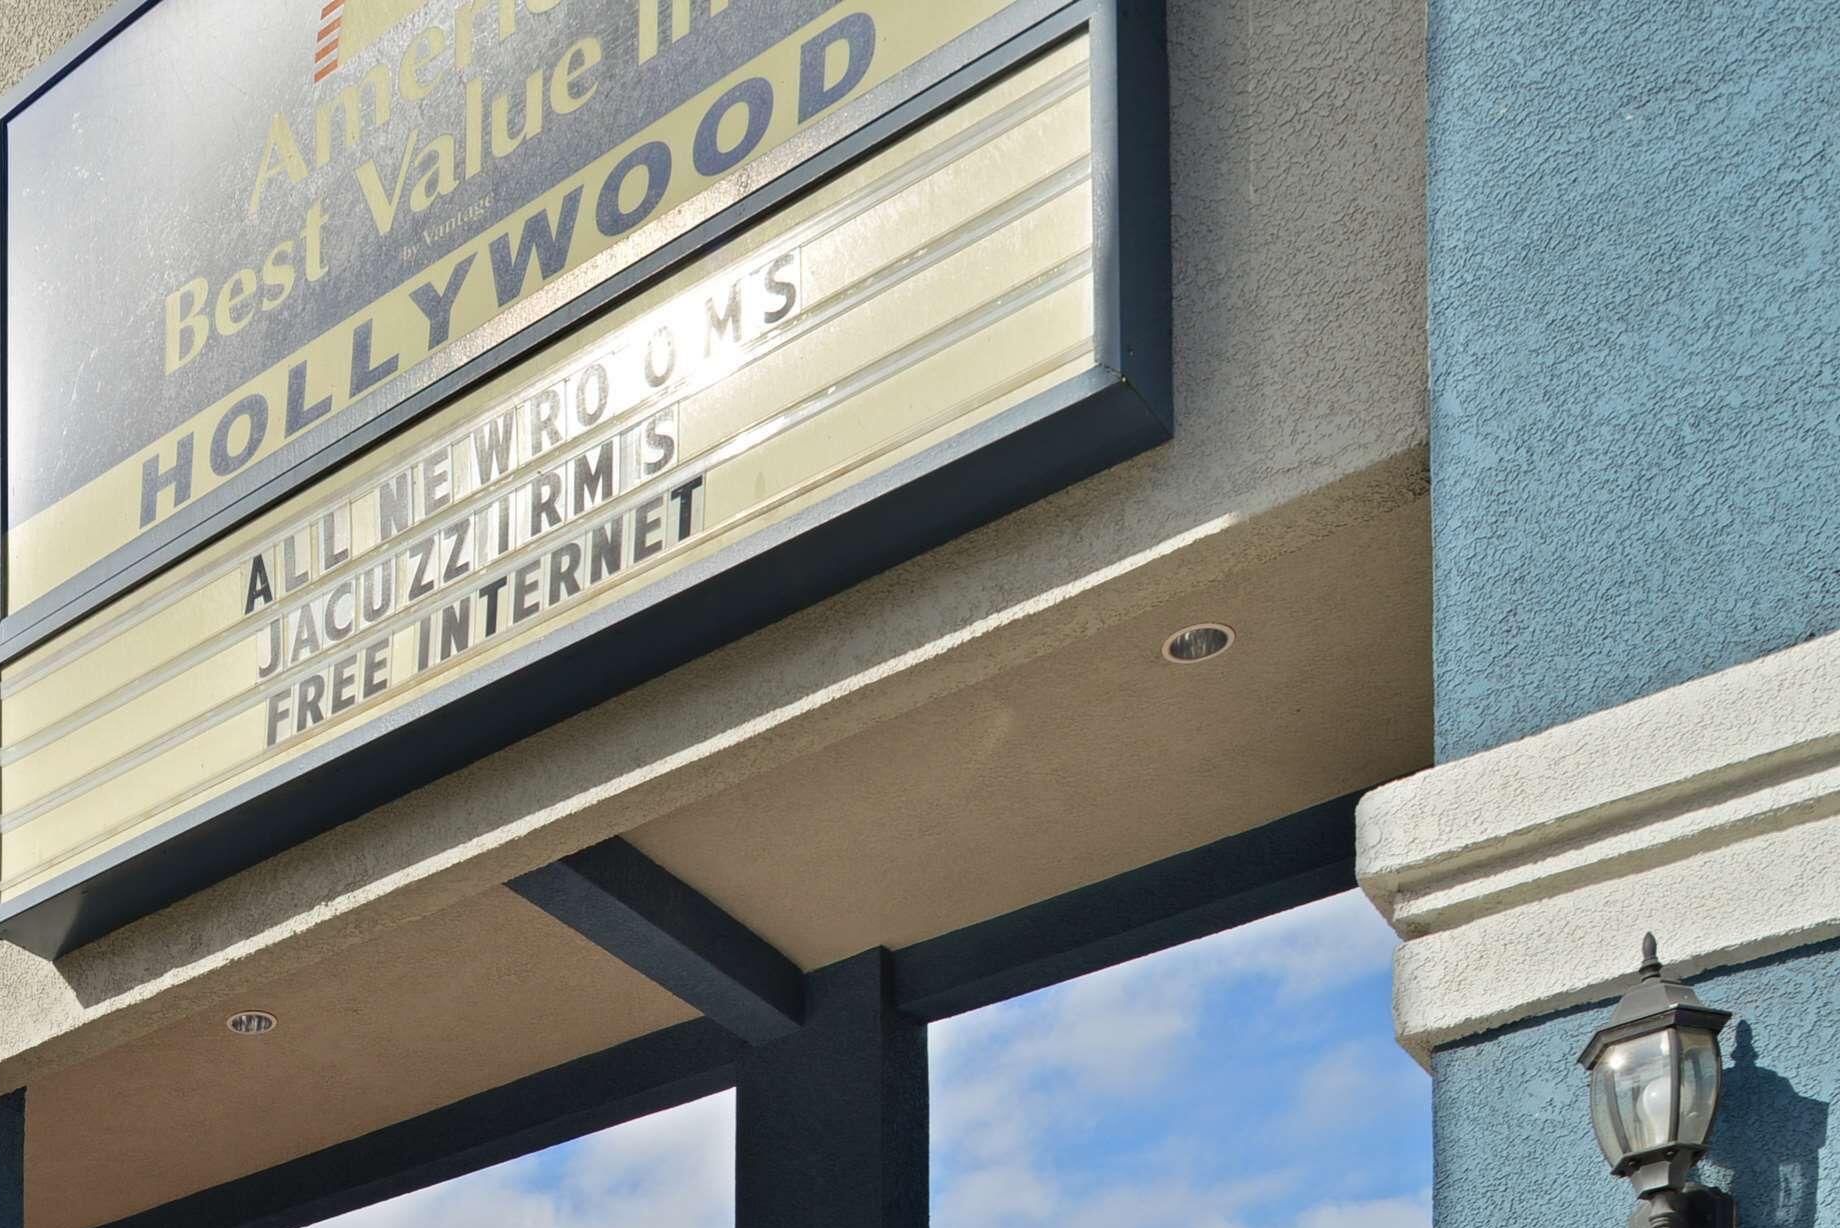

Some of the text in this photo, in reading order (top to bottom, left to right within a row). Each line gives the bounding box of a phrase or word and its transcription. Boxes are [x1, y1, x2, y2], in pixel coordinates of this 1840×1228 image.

[164, 37, 602, 376] Best Value
[248, 0, 562, 224] Ameri
[423, 191, 494, 247] Vantage
[139, 12, 877, 529] HOLLYWOOD
[244, 511, 351, 615] ALL
[266, 476, 704, 747] FREE INTERNET
